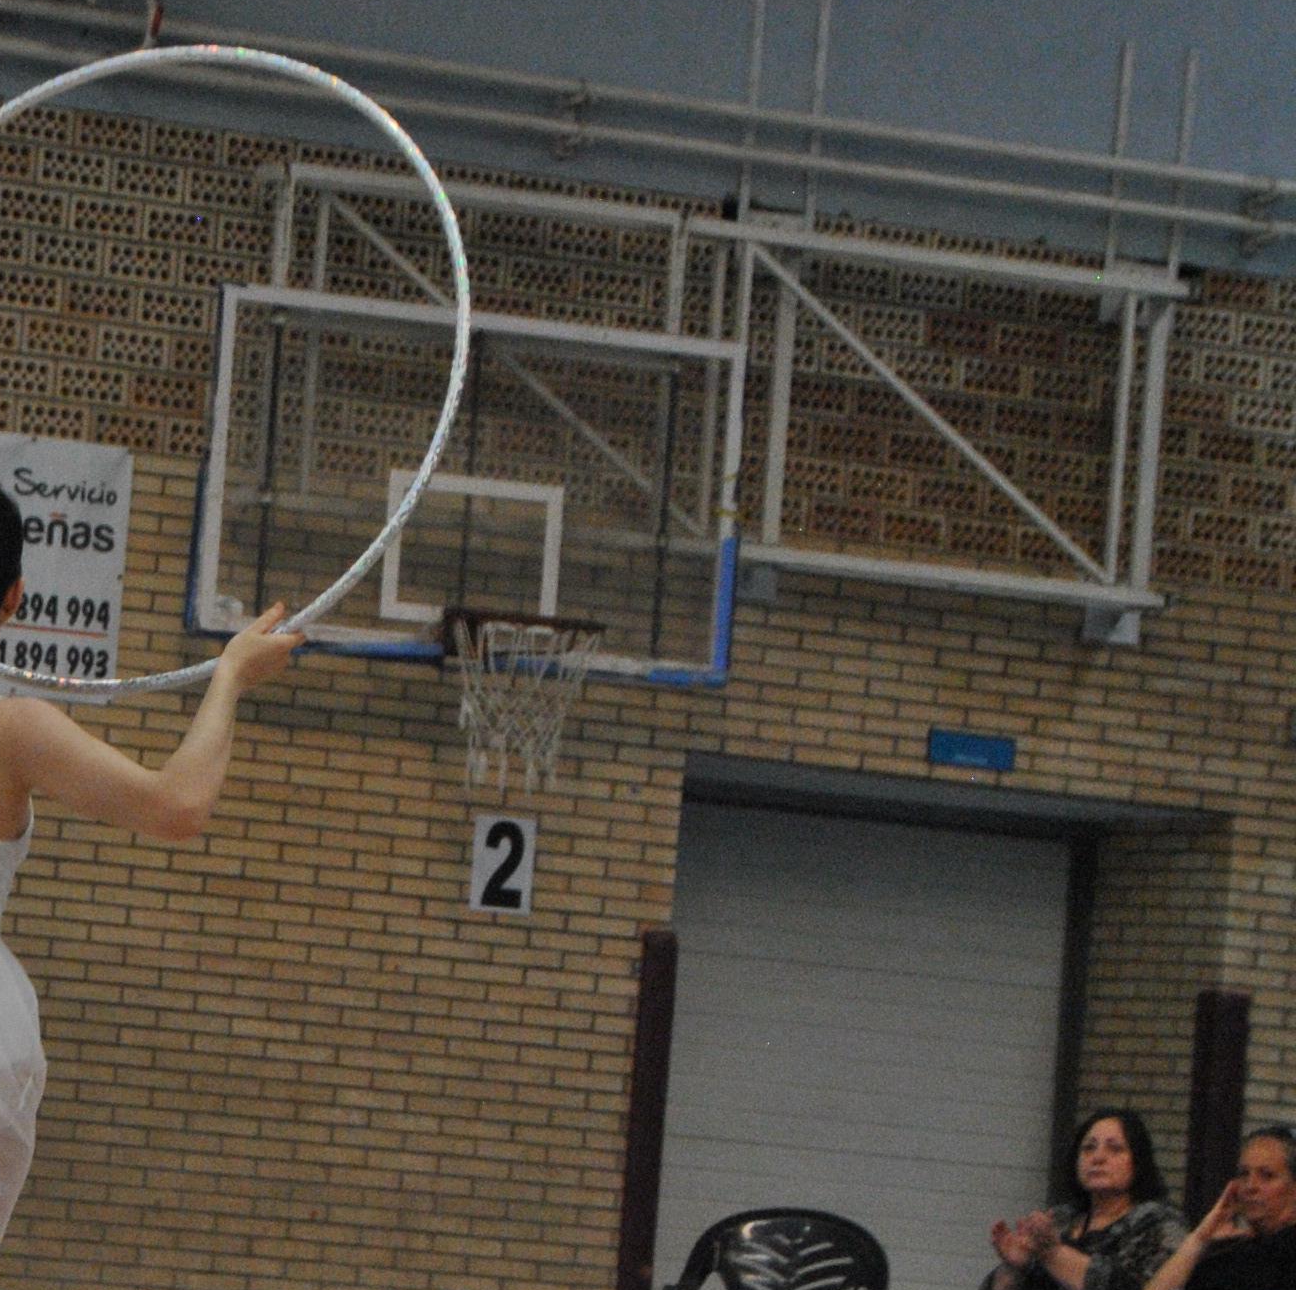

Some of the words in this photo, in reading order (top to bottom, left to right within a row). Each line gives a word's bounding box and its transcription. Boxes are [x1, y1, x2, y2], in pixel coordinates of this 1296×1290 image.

[14, 467, 117, 507] Servicio
[22, 511, 115, 553] eñas
[67, 597, 110, 631] 994
[14, 641, 59, 676] 894
[67, 645, 109, 679] 993
[481, 820, 526, 908] 2
